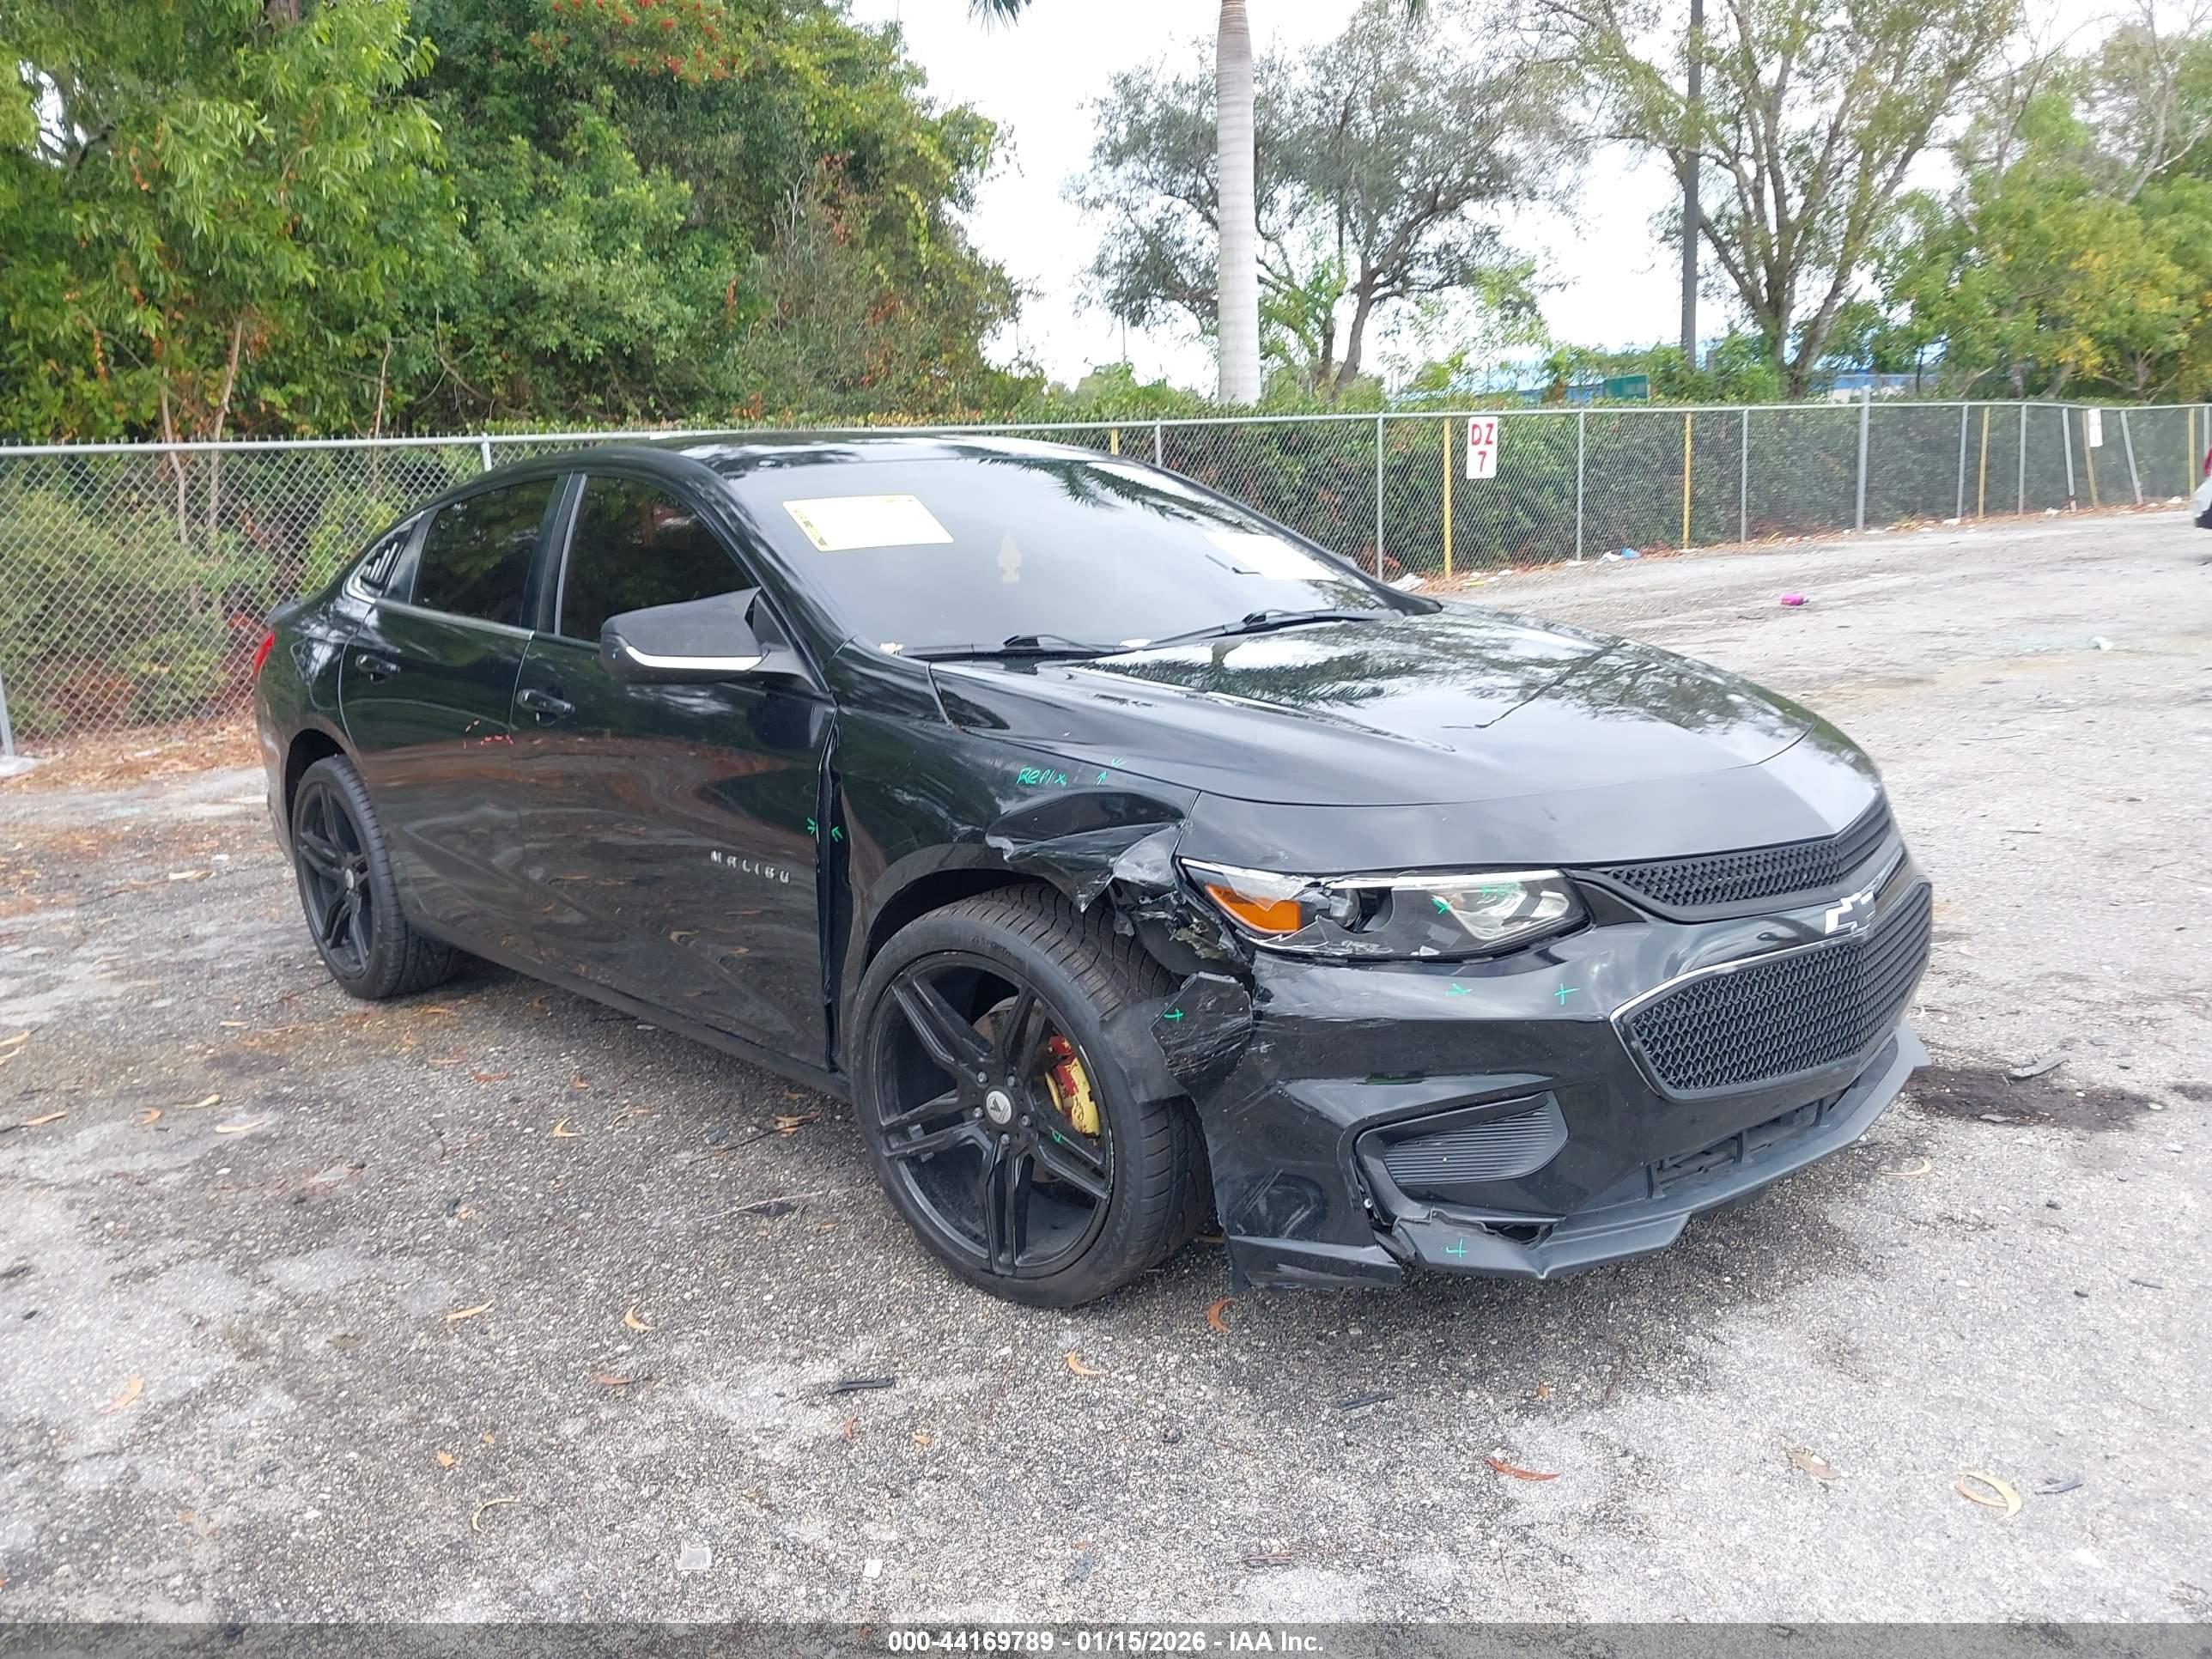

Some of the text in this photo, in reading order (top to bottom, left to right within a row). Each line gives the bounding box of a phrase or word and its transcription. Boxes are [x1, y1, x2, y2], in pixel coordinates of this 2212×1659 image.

[1471, 422, 1494, 446] DZ
[1478, 450, 1487, 473] 7
[710, 850, 790, 884] MALIBU
